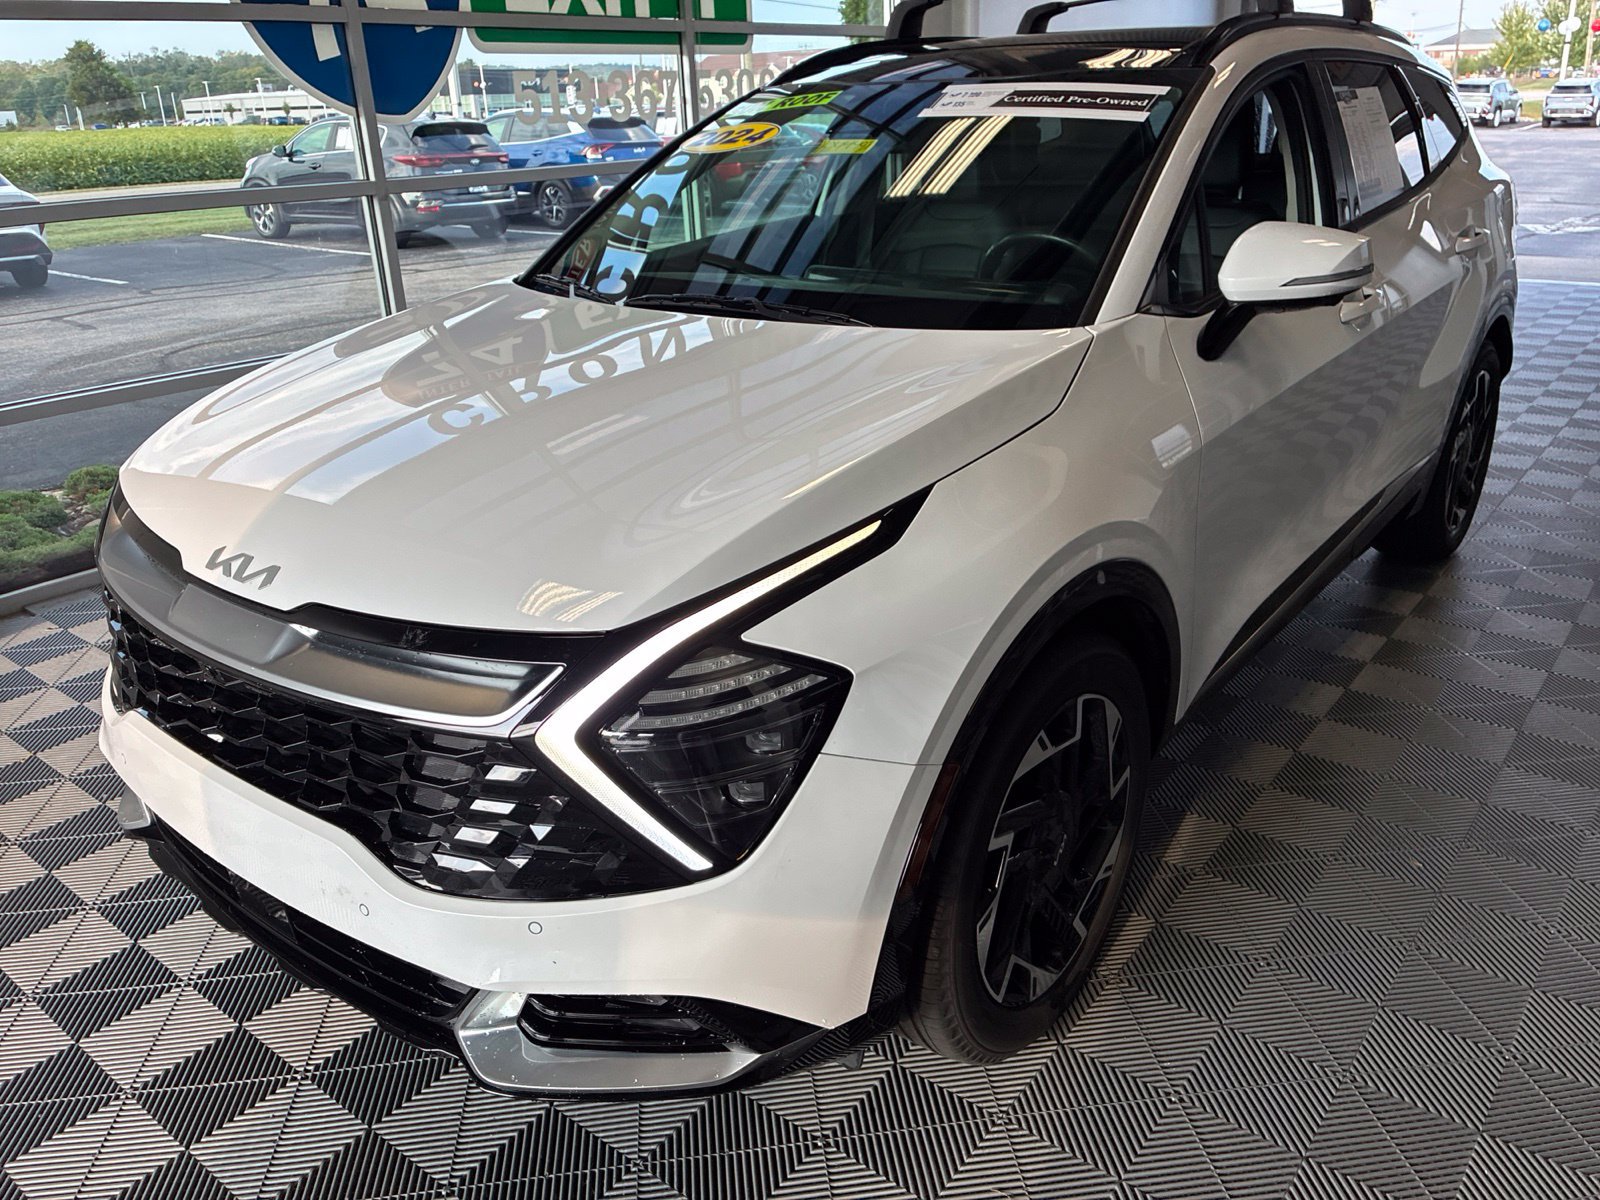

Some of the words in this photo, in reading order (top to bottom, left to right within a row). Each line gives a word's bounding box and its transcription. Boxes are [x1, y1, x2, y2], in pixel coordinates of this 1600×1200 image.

[772, 92, 834, 109] ROOF
[1003, 95, 1065, 103] Certified
[1066, 95, 1149, 107] Pre-Owned
[688, 127, 775, 147] 2024
